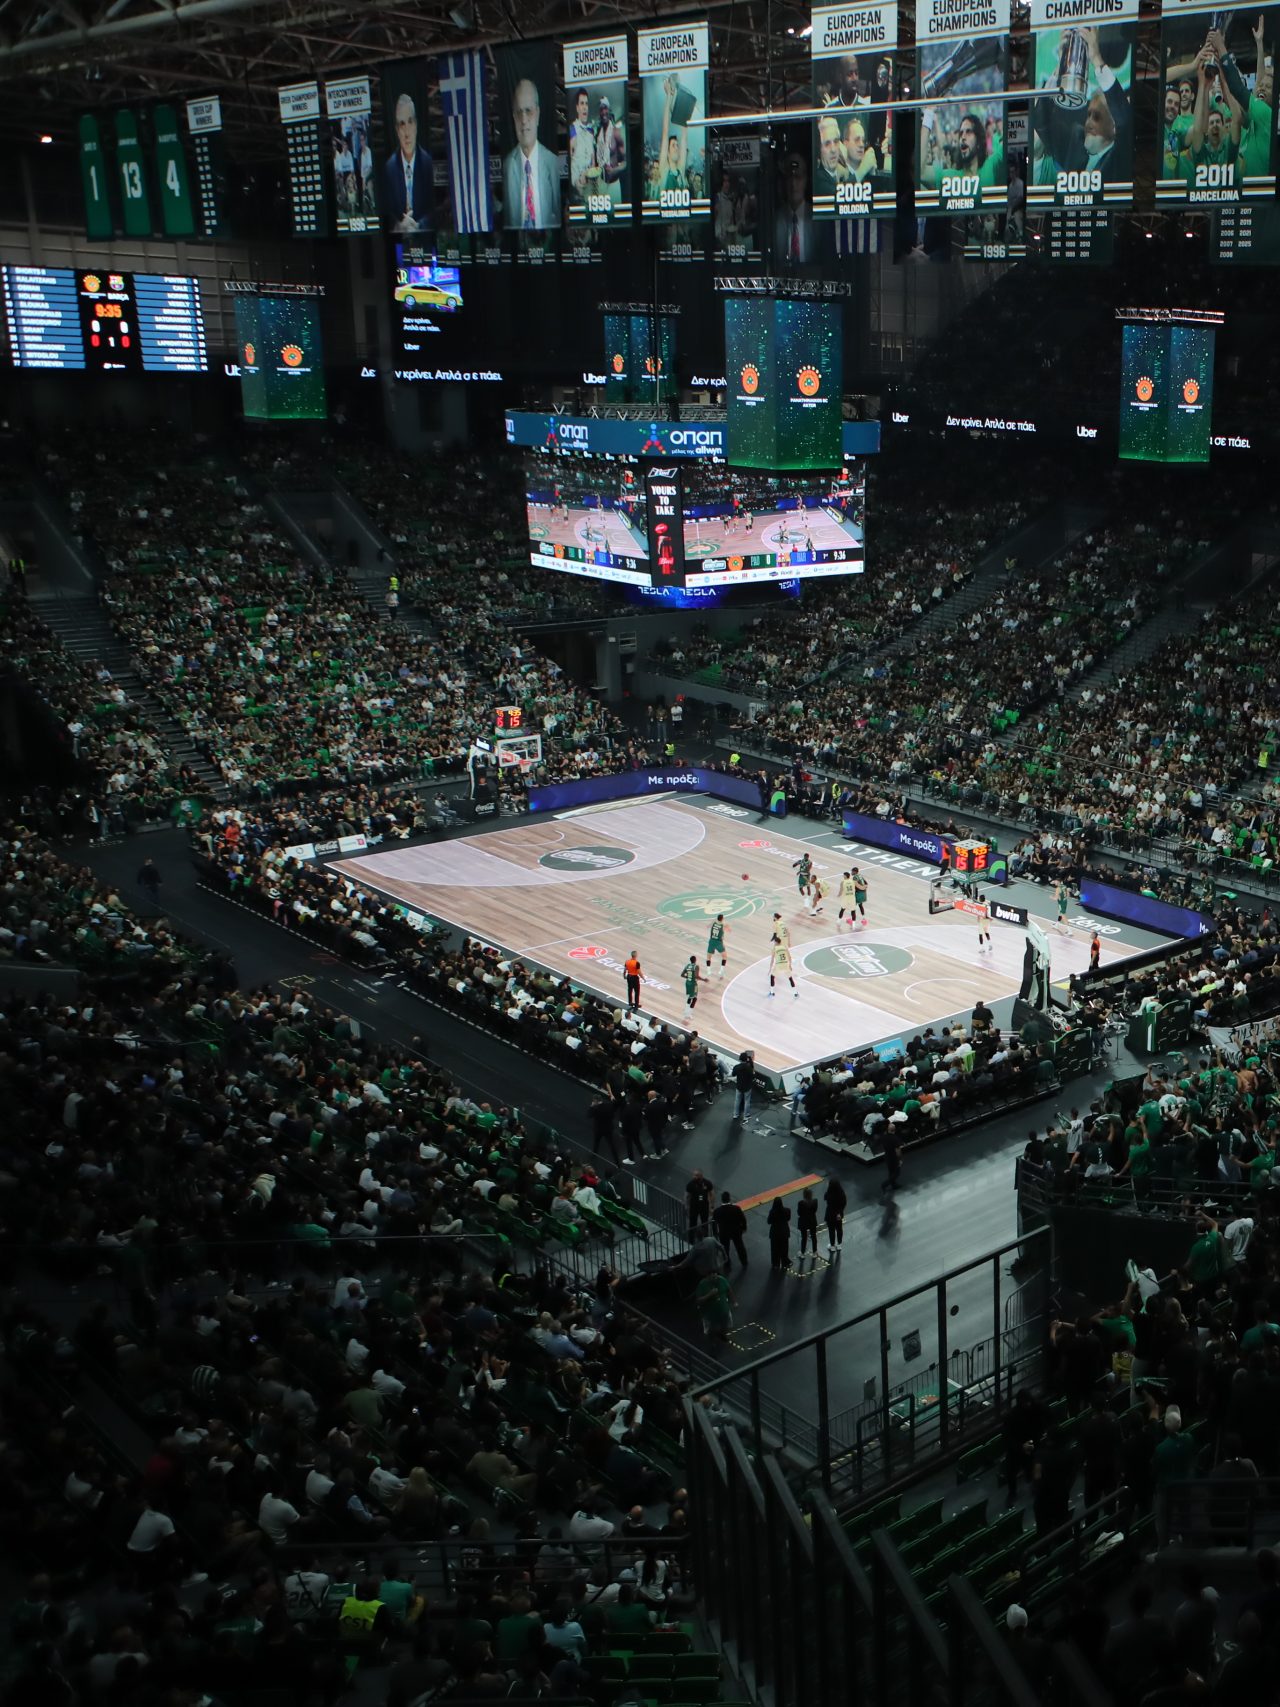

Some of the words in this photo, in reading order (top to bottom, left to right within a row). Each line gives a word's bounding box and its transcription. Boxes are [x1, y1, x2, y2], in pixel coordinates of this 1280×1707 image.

[827, 10, 882, 31] EUROPEAN
[929, 10, 997, 33] CHAMPIONS
[651, 33, 695, 51] EUROPEAN
[823, 26, 885, 48] CHAMPIONS
[574, 46, 615, 64] EUROPEAN
[648, 49, 698, 66] CHAMPIONS
[572, 61, 618, 78] CHAMPIONS
[122, 161, 143, 198] 13
[165, 160, 180, 197] 4
[1056, 171, 1101, 193] 2009
[1195, 164, 1235, 187] 2011
[90, 166, 99, 200] 1
[941, 176, 980, 197] 2007
[660, 189, 690, 207] 2000
[836, 182, 872, 202] 2002
[1189, 190, 1239, 202] BARCELONA
[588, 195, 611, 211] 1996
[946, 198, 975, 210] ATHENS
[1064, 195, 1093, 205] BERLIN
[839, 203, 870, 214] BOLOGNA
[727, 245, 746, 257] 1996
[983, 245, 1006, 258] 1996
[95, 304, 123, 318] 9:35
[91, 334, 100, 347] 0
[121, 335, 131, 348] 0
[583, 373, 607, 384] Uber
[691, 376, 708, 385] Δεν
[892, 412, 909, 423] Uber
[946, 415, 961, 427] Δεν
[984, 418, 1005, 430] Απλά
[1006, 421, 1016, 430] σε
[1076, 425, 1097, 438] Uber
[1215, 436, 1226, 446] σε
[695, 445, 722, 456] allwyn
[651, 486, 677, 495] YOURS
[659, 496, 670, 505] TO
[655, 506, 675, 515] TAKE
[638, 586, 670, 596] TESLA
[679, 588, 716, 597] TESLA
[510, 717, 520, 727] 15
[648, 775, 664, 785] Με
[900, 834, 912, 845] Με
[832, 843, 940, 877] ATHEN
[956, 857, 967, 870] 15
[974, 855, 986, 869] 15
